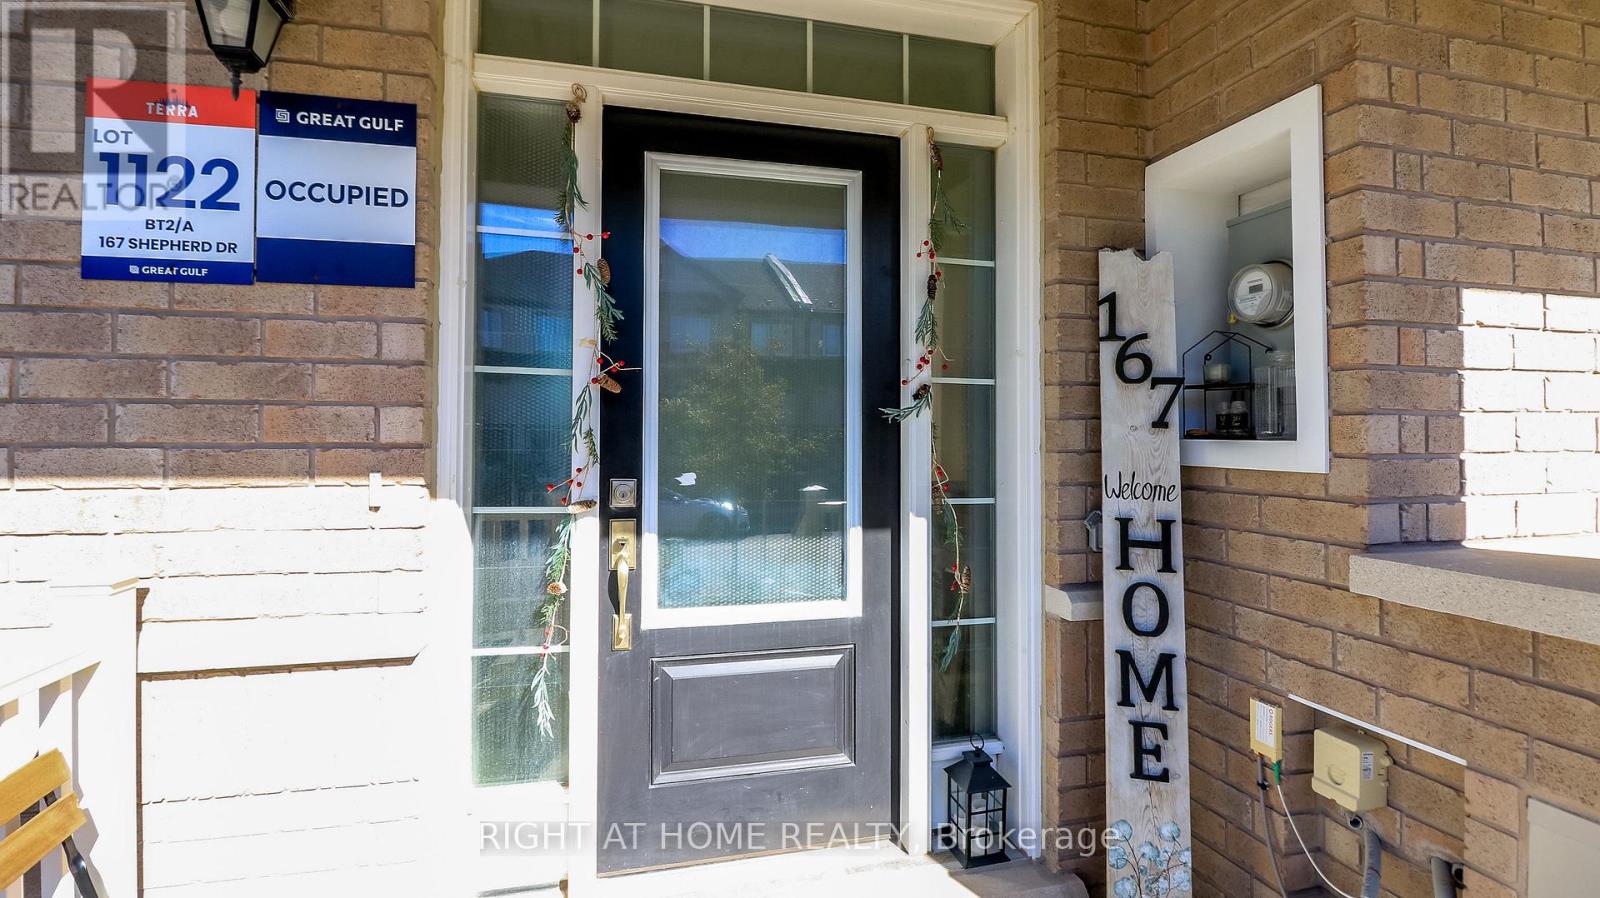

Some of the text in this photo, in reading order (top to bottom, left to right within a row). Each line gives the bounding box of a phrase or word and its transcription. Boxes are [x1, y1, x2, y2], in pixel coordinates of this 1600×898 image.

[146, 102, 199, 118] TERRA
[296, 111, 404, 132] GREAT GULF
[94, 128, 133, 145] LOT
[99, 152, 240, 211] 1122
[265, 180, 409, 208] OCCUPIED
[145, 217, 195, 234] BT2/A
[99, 236, 238, 254] 167 SHEPHERD DR
[141, 265, 208, 277] GREAT GULF
[1098, 291, 1185, 429] 167
[1104, 471, 1178, 502] Welcome
[1114, 517, 1180, 783] HOME
